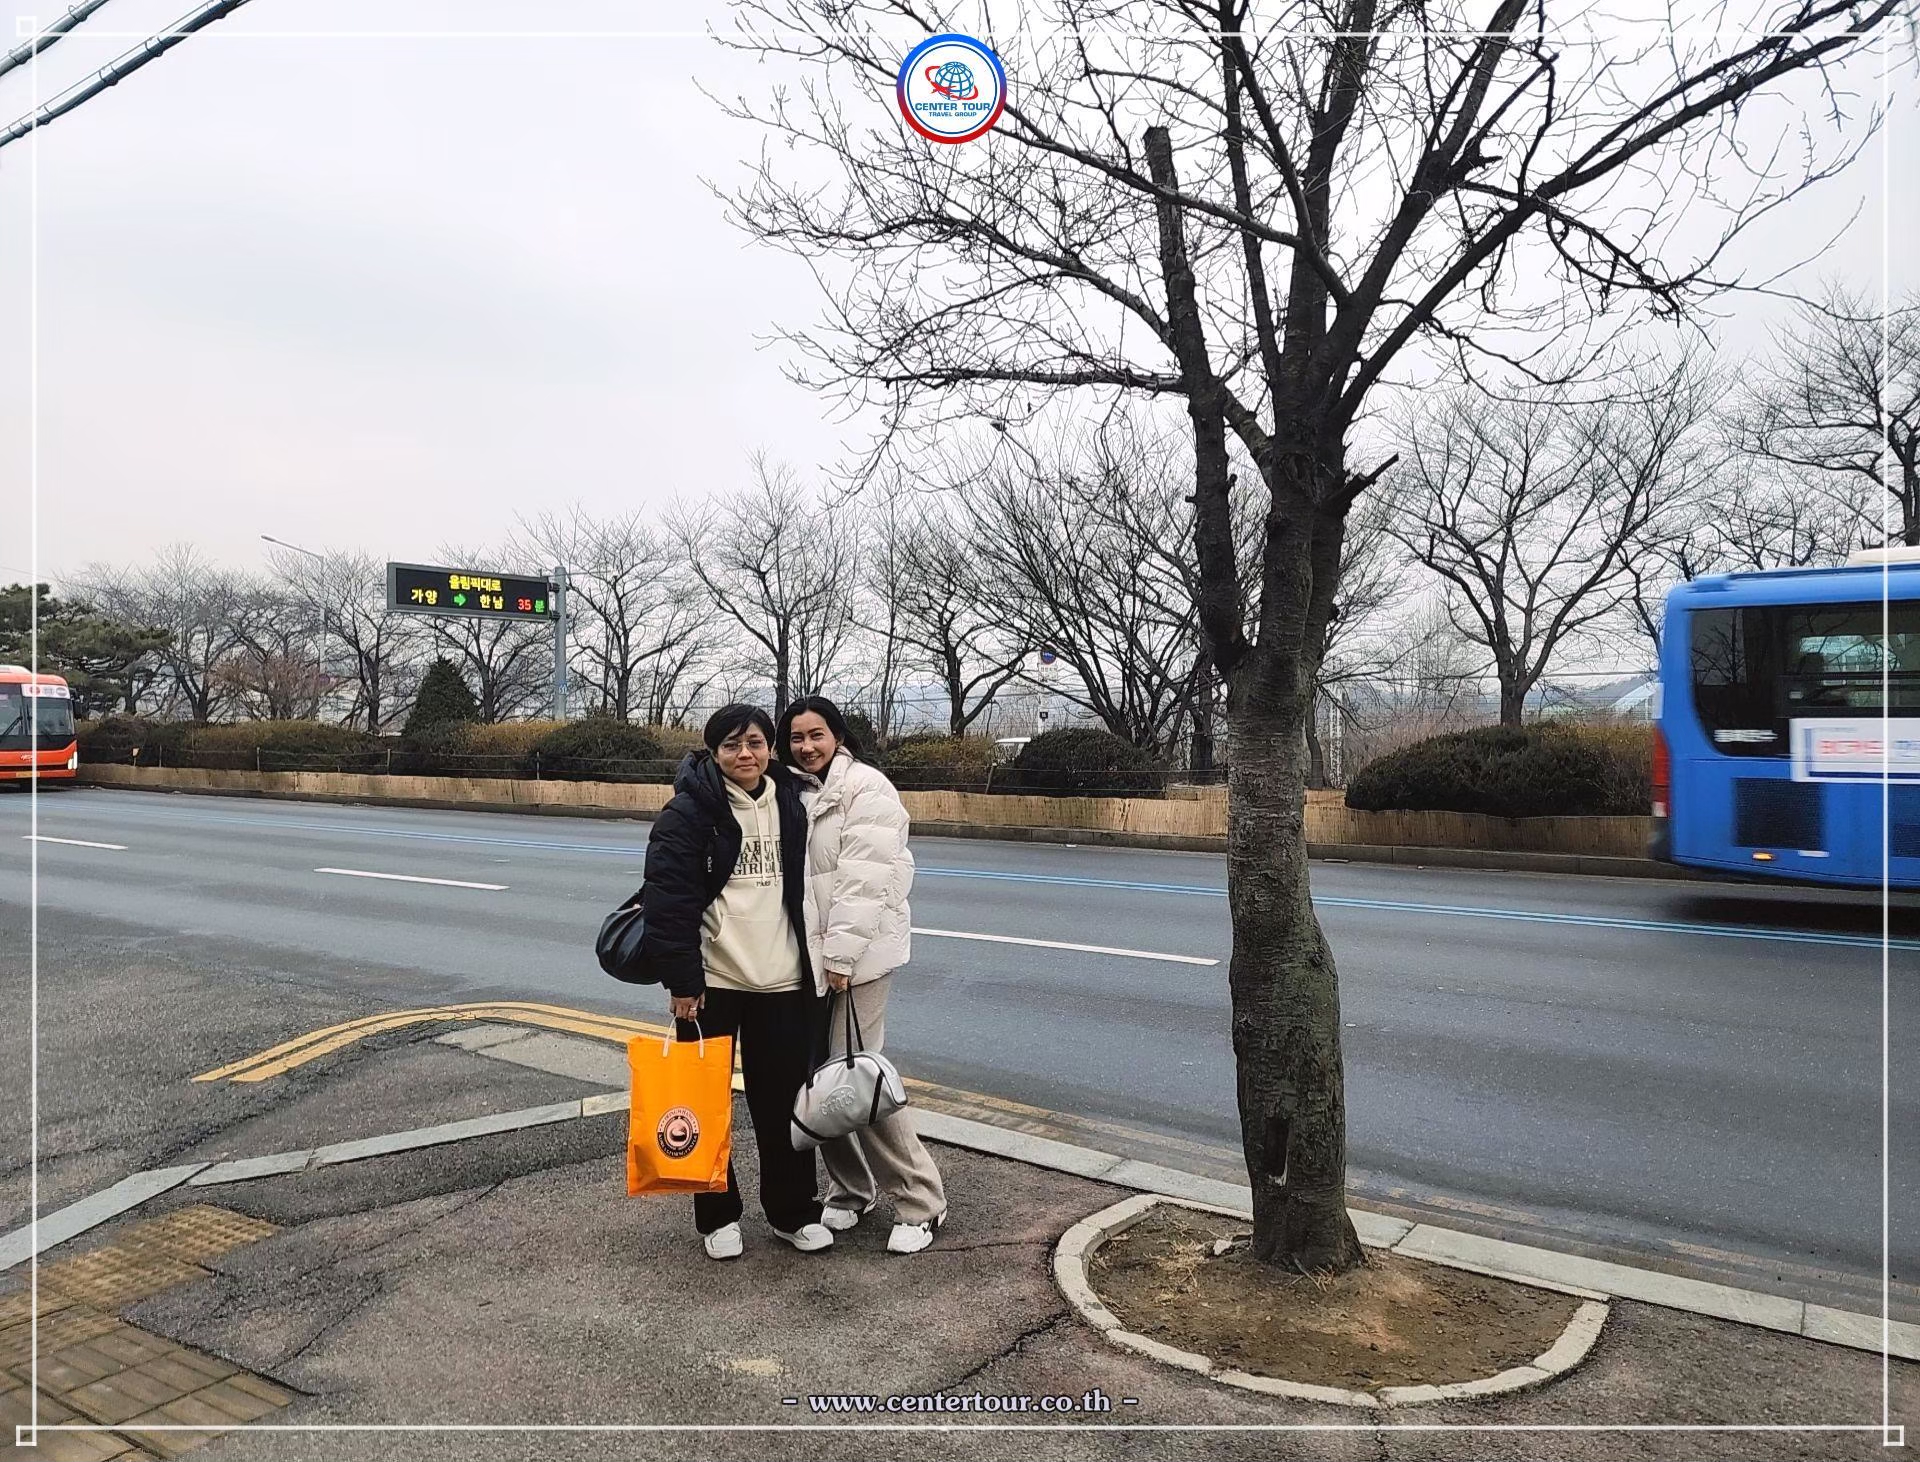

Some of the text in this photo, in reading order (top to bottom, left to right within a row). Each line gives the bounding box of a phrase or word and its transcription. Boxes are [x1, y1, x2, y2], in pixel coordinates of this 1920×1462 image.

[449, 574, 502, 591] 올림픽대로
[411, 588, 438, 605] 가양
[479, 594, 504, 610] 한남
